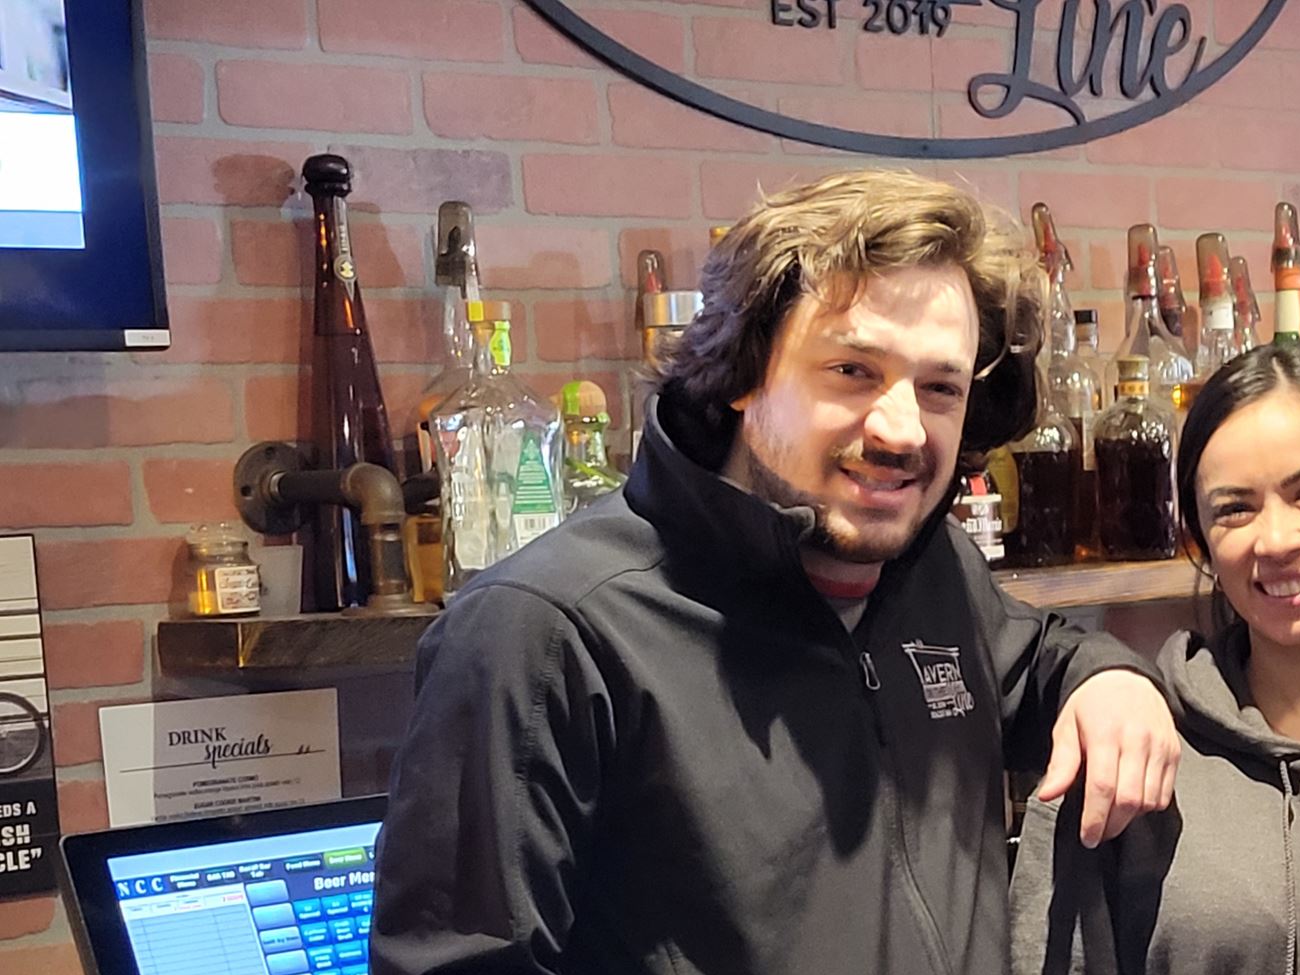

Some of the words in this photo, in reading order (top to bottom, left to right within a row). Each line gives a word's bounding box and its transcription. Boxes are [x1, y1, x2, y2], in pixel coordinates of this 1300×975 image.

[770, 0, 837, 29] EST
[862, 0, 952, 38] 2019
[168, 727, 227, 747] DRINK
[203, 734, 273, 769] specials
[0, 802, 22, 819] DS
[26, 801, 37, 815] A
[313, 874, 347, 892] Beer
